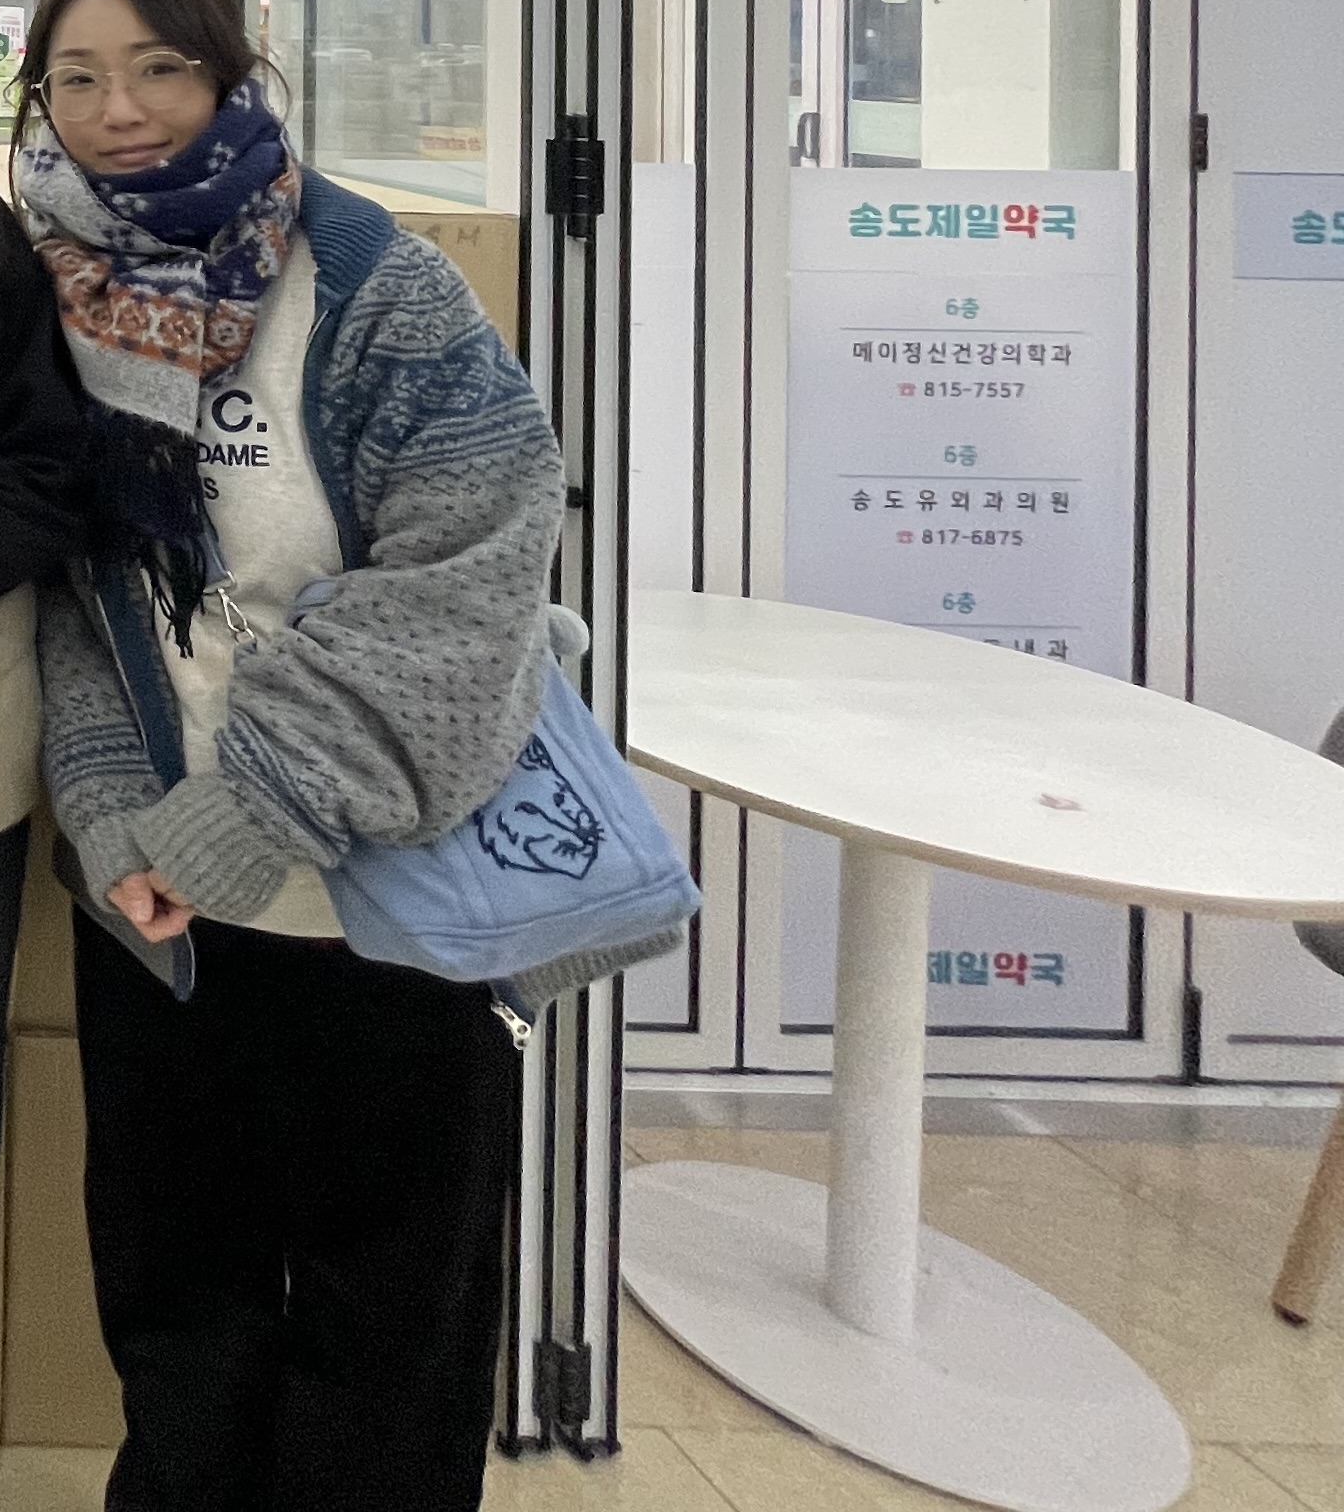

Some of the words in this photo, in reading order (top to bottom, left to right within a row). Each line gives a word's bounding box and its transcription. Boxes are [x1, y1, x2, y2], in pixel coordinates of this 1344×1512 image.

[849, 202, 1077, 240] 송도제일약국
[945, 298, 980, 319] 6층
[923, 381, 1025, 399] 815-7557
[921, 529, 1024, 547] 817-6875
